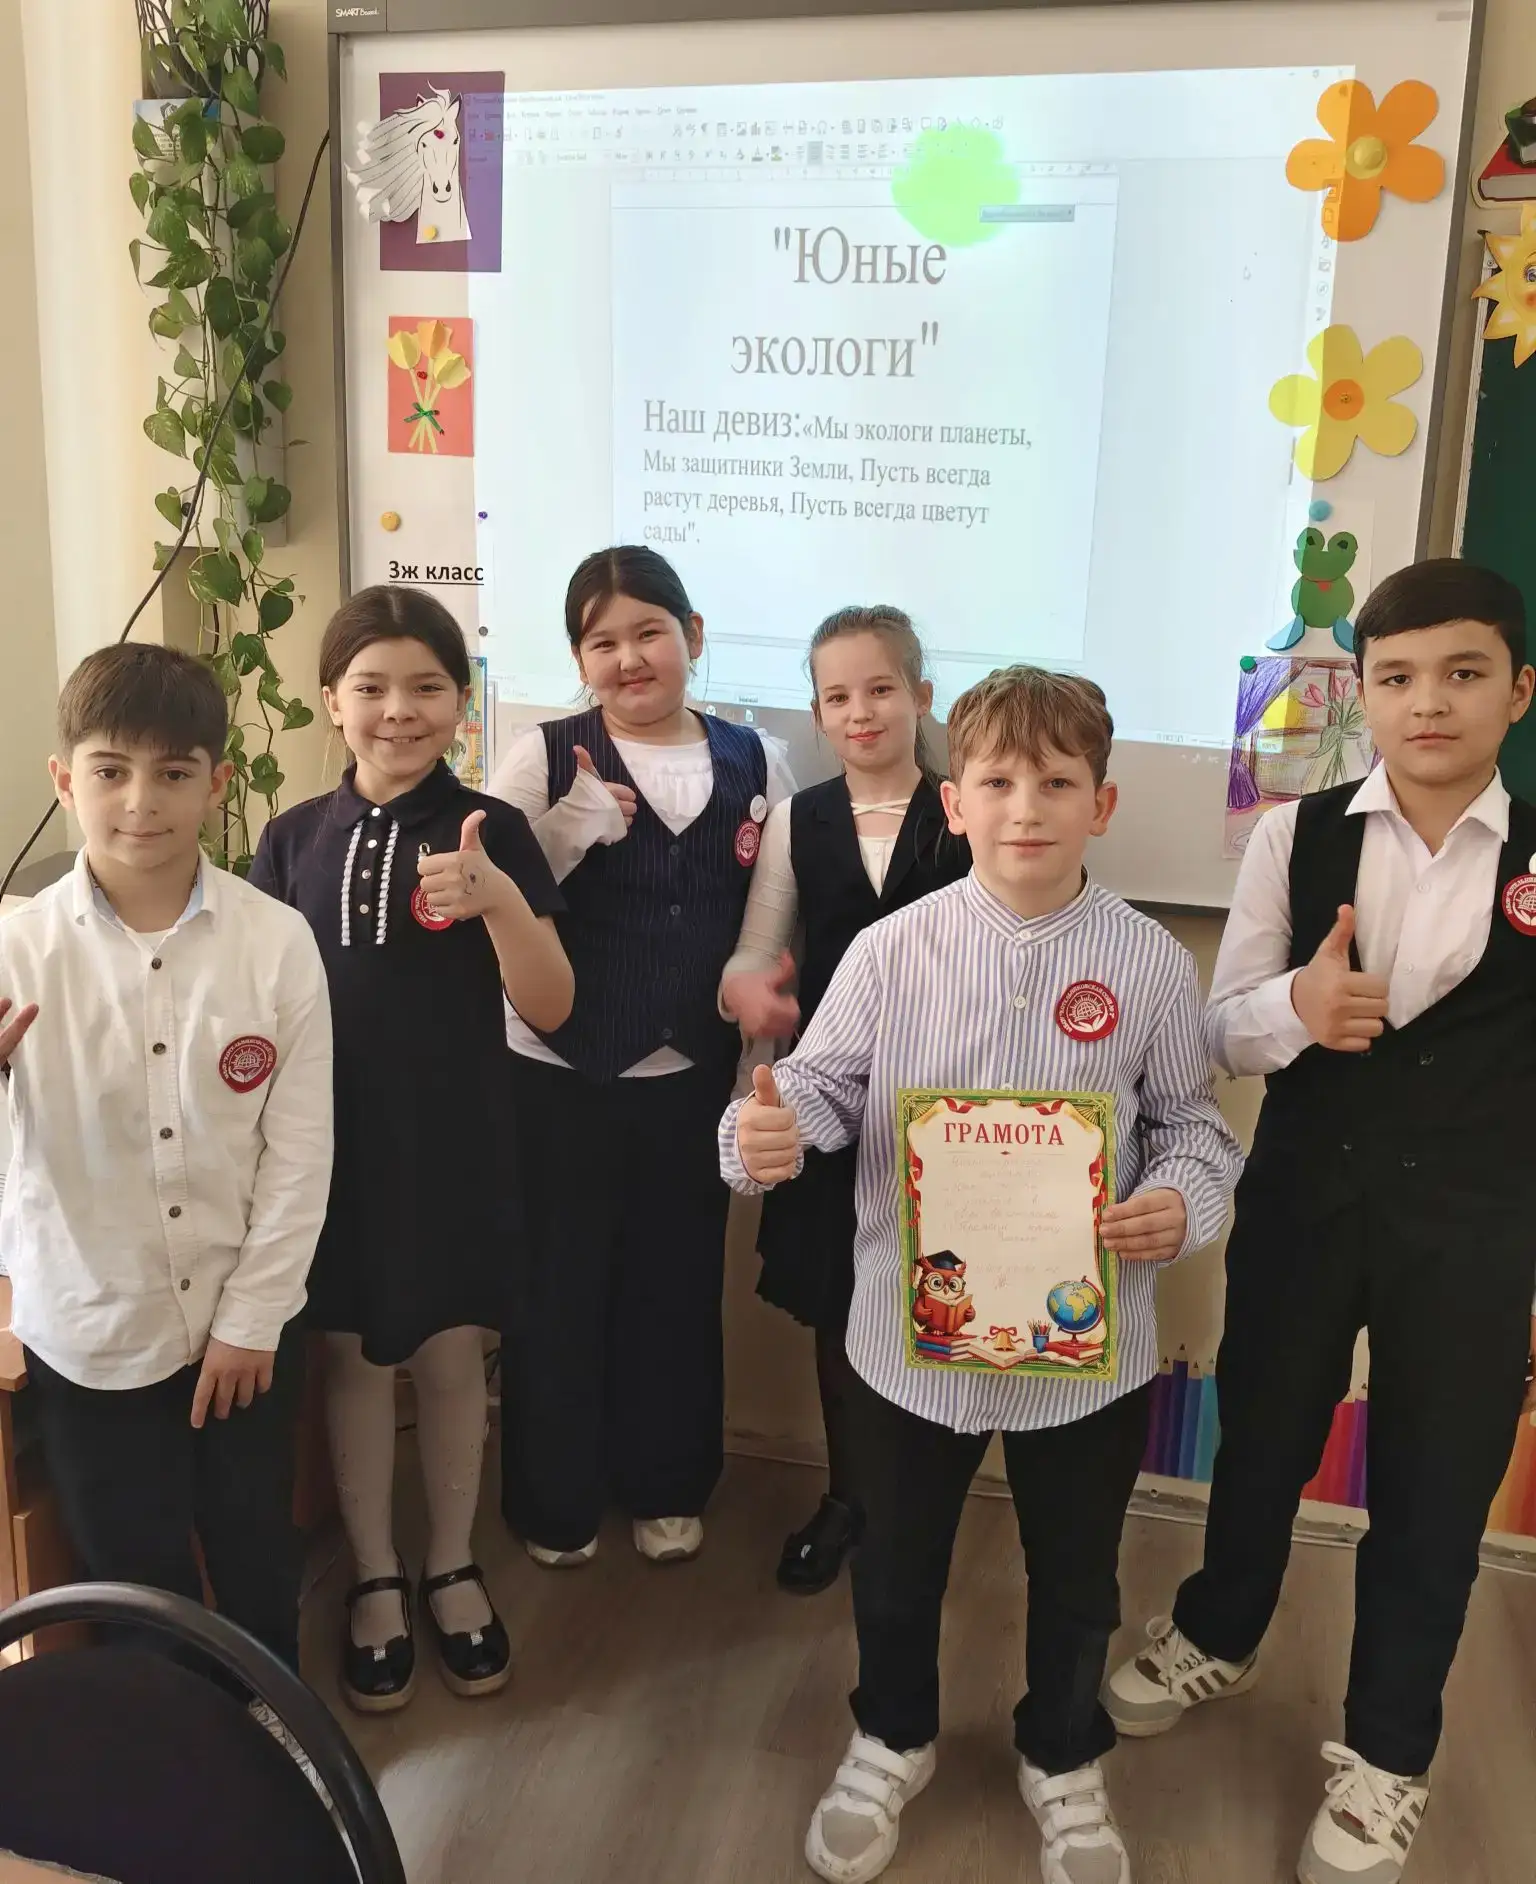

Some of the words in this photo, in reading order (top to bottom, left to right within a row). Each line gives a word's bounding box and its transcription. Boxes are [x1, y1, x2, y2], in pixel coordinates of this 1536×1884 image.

[335, 7, 360, 17] SMART
[773, 226, 947, 285] "Юные
[730, 321, 940, 378] экологи"
[644, 399, 706, 434] Наш
[855, 422, 933, 442] экологи
[940, 425, 1032, 450] планеты,
[644, 449, 676, 472] Мы
[681, 455, 783, 477] защитники
[789, 454, 854, 483] Земли,
[861, 458, 919, 487] Пусть
[926, 465, 992, 488] всегда
[643, 489, 702, 514] растут
[707, 493, 784, 516] деревья,
[791, 491, 848, 520] Пусть
[853, 500, 915, 521] всегда
[922, 503, 990, 529] цветут
[643, 521, 700, 544] сады".
[388, 560, 418, 580] 3ж
[426, 564, 484, 581] класс
[943, 1121, 1065, 1146] ГРАМОТА
